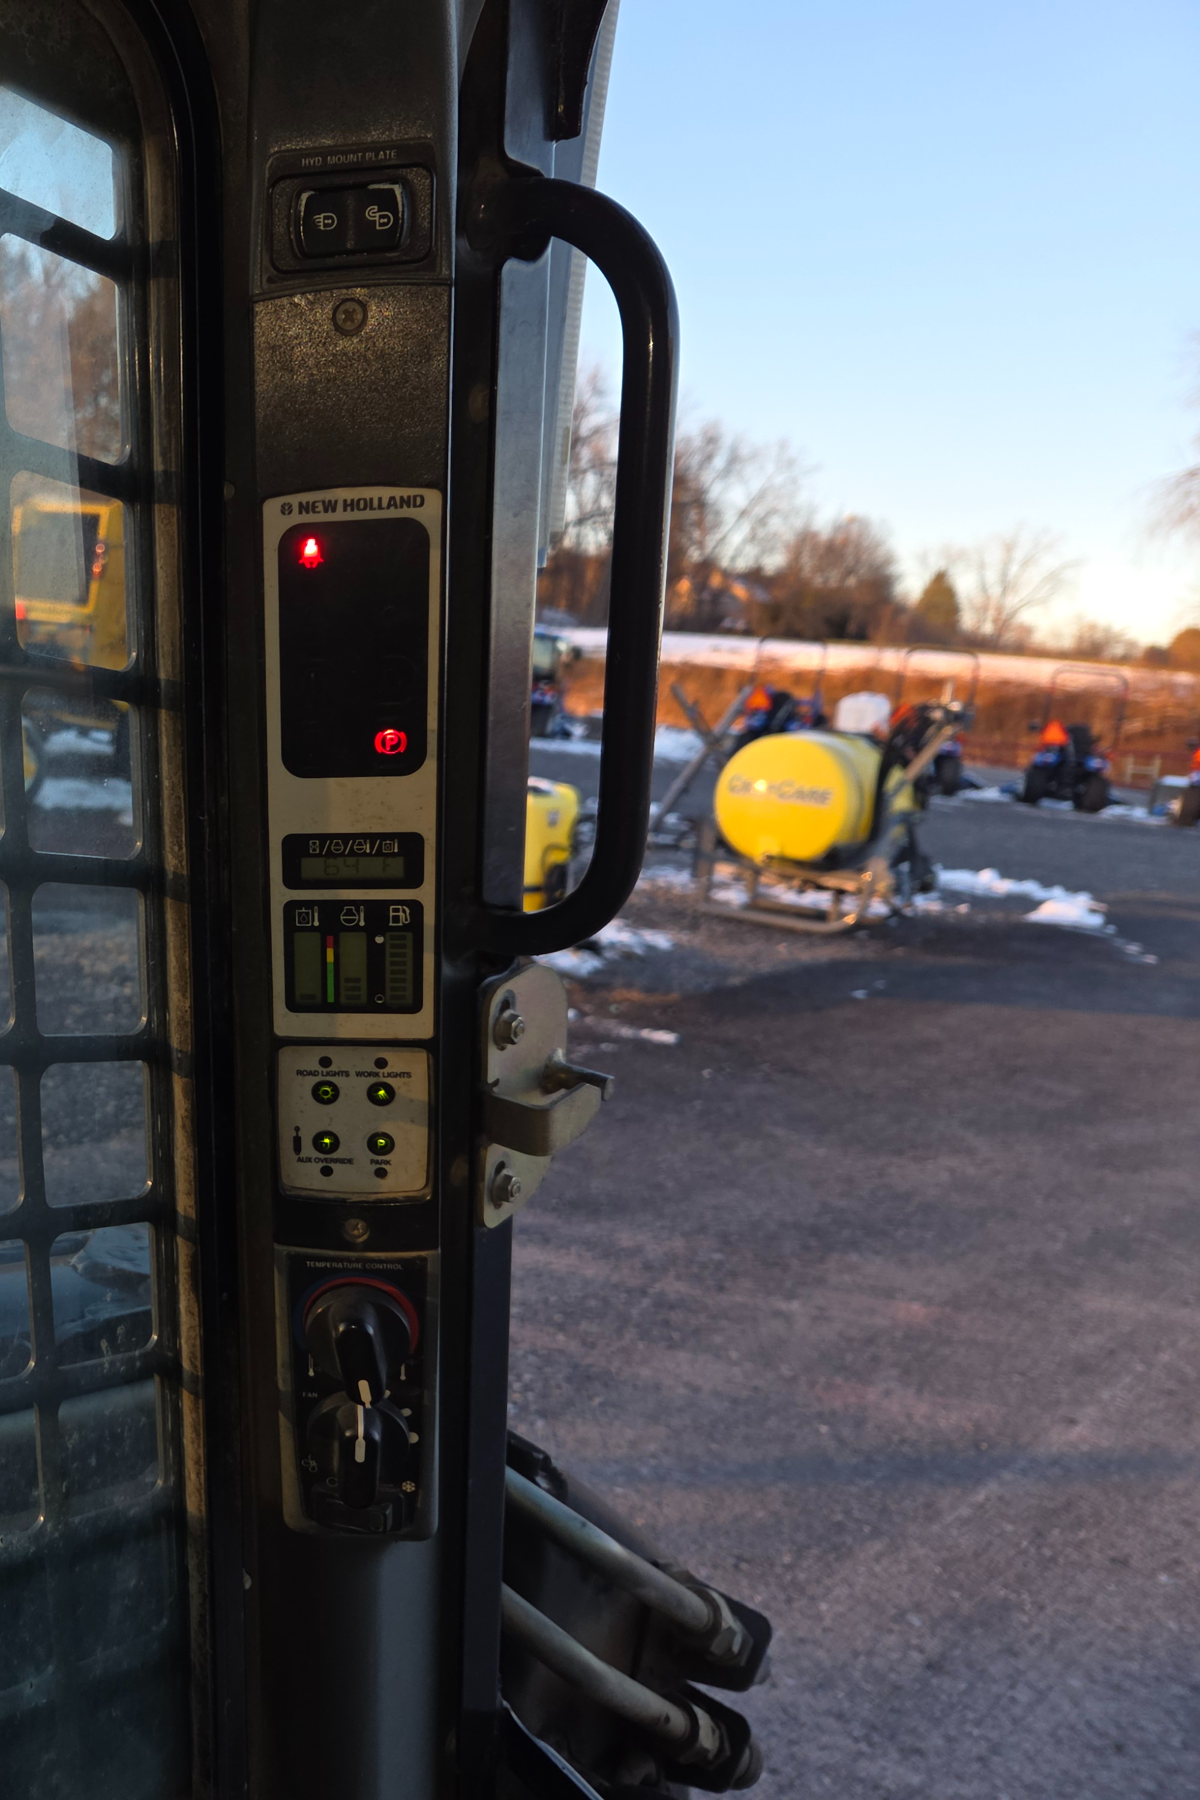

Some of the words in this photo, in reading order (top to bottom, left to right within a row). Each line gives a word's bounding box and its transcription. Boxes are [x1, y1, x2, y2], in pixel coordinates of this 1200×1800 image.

[301, 157, 323, 168] HYD
[327, 153, 363, 165] MOUNT
[365, 150, 398, 162] PLATE
[298, 499, 339, 516] NEW
[342, 494, 426, 512] HOLLAND
[385, 734, 399, 751] P
[324, 856, 360, 876] 64
[296, 1069, 320, 1077] ROAD
[321, 1070, 350, 1078] LIGHTS
[355, 1070, 381, 1078] WORK
[382, 1071, 412, 1079] LIGHTS
[296, 1156, 313, 1164] AUX
[314, 1157, 354, 1165] OVERRIDE
[306, 1261, 363, 1269] TEMPERATURE
